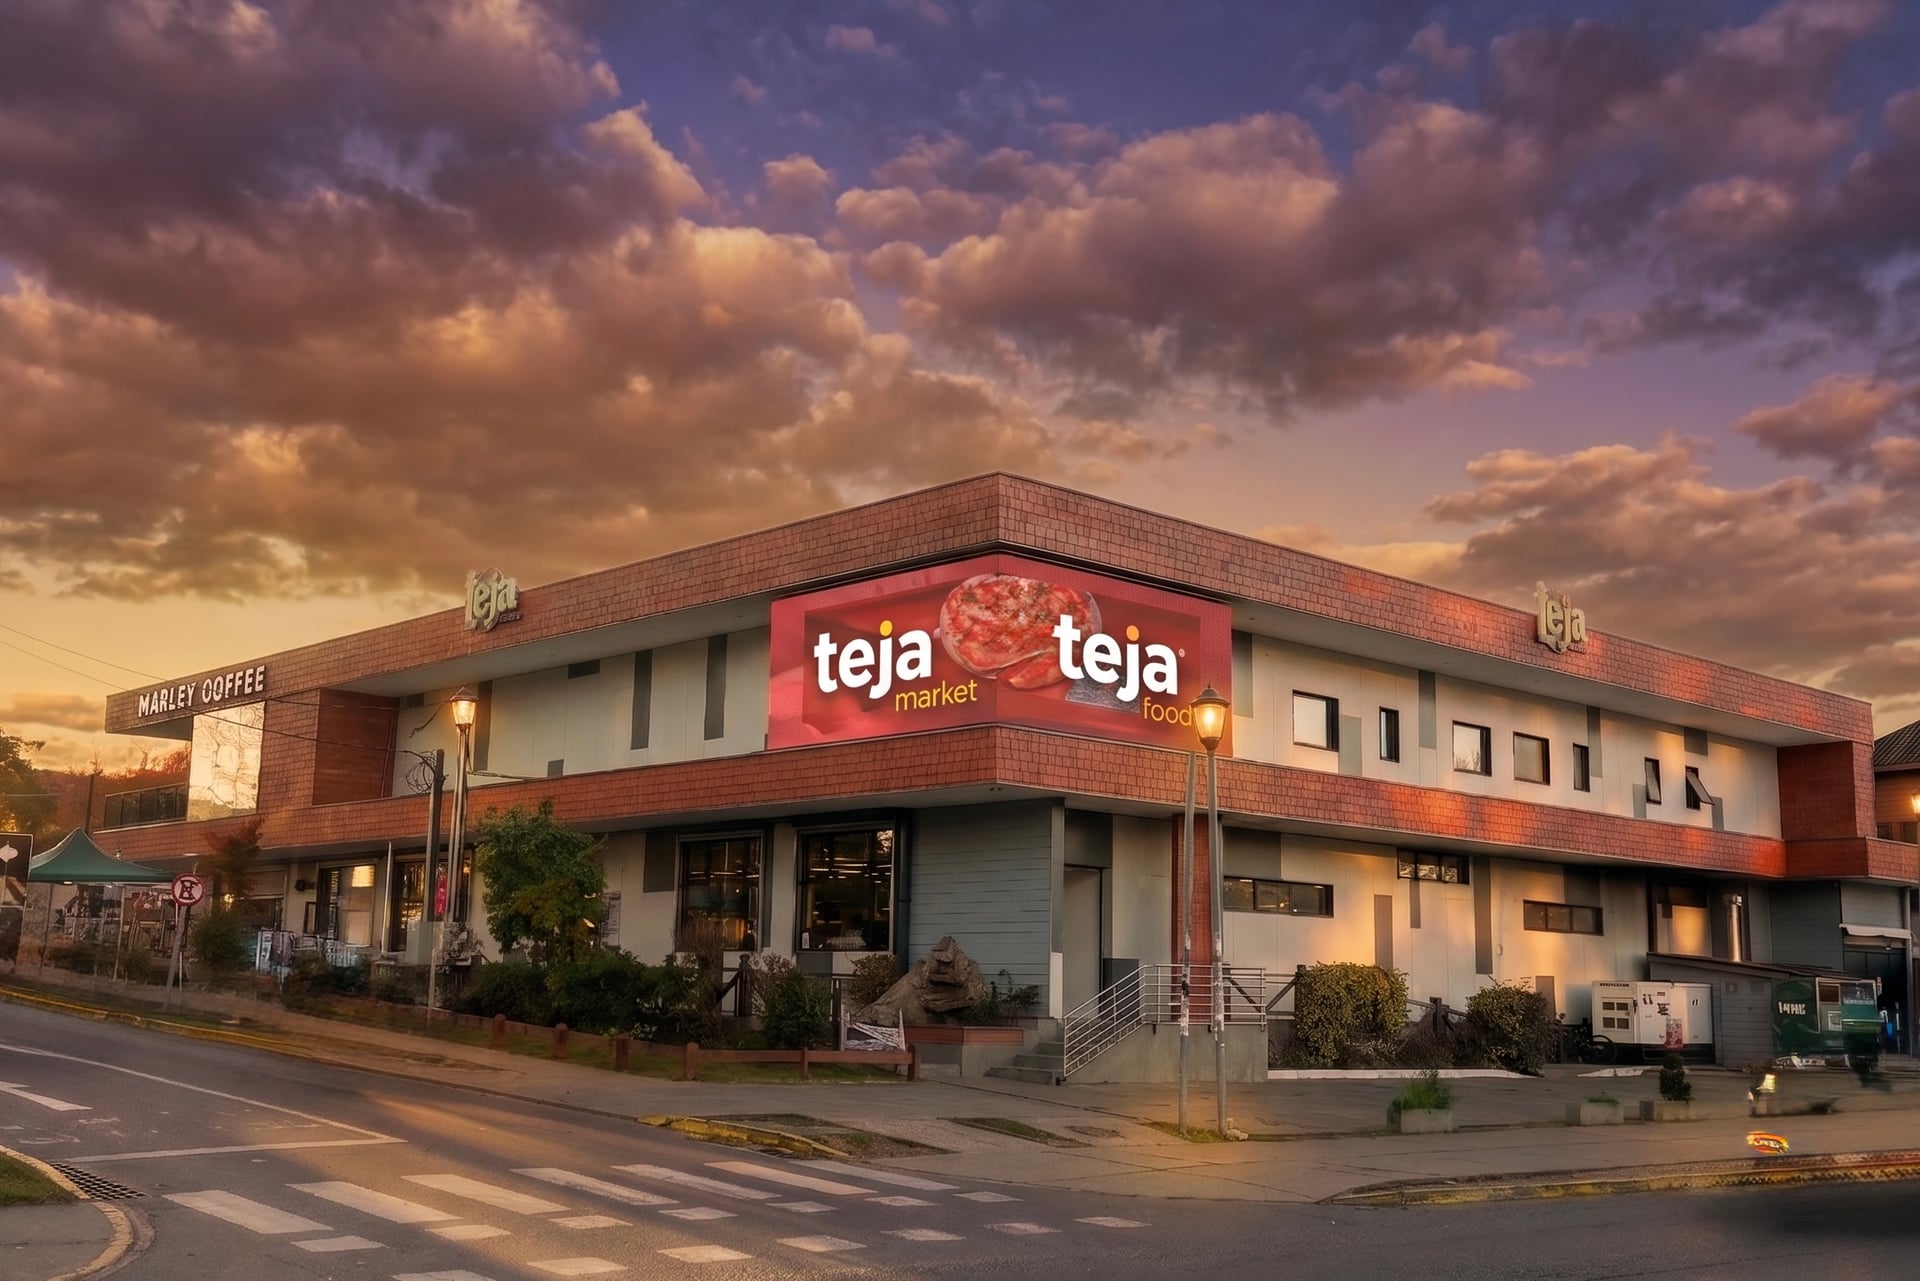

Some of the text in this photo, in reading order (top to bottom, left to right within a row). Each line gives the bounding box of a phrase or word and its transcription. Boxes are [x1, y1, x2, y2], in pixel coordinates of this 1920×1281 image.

[813, 619, 932, 699] teja
[1051, 614, 1178, 702] teja
[138, 681, 196, 717] MARLEY
[895, 679, 978, 712] market
[1143, 696, 1192, 727] food
